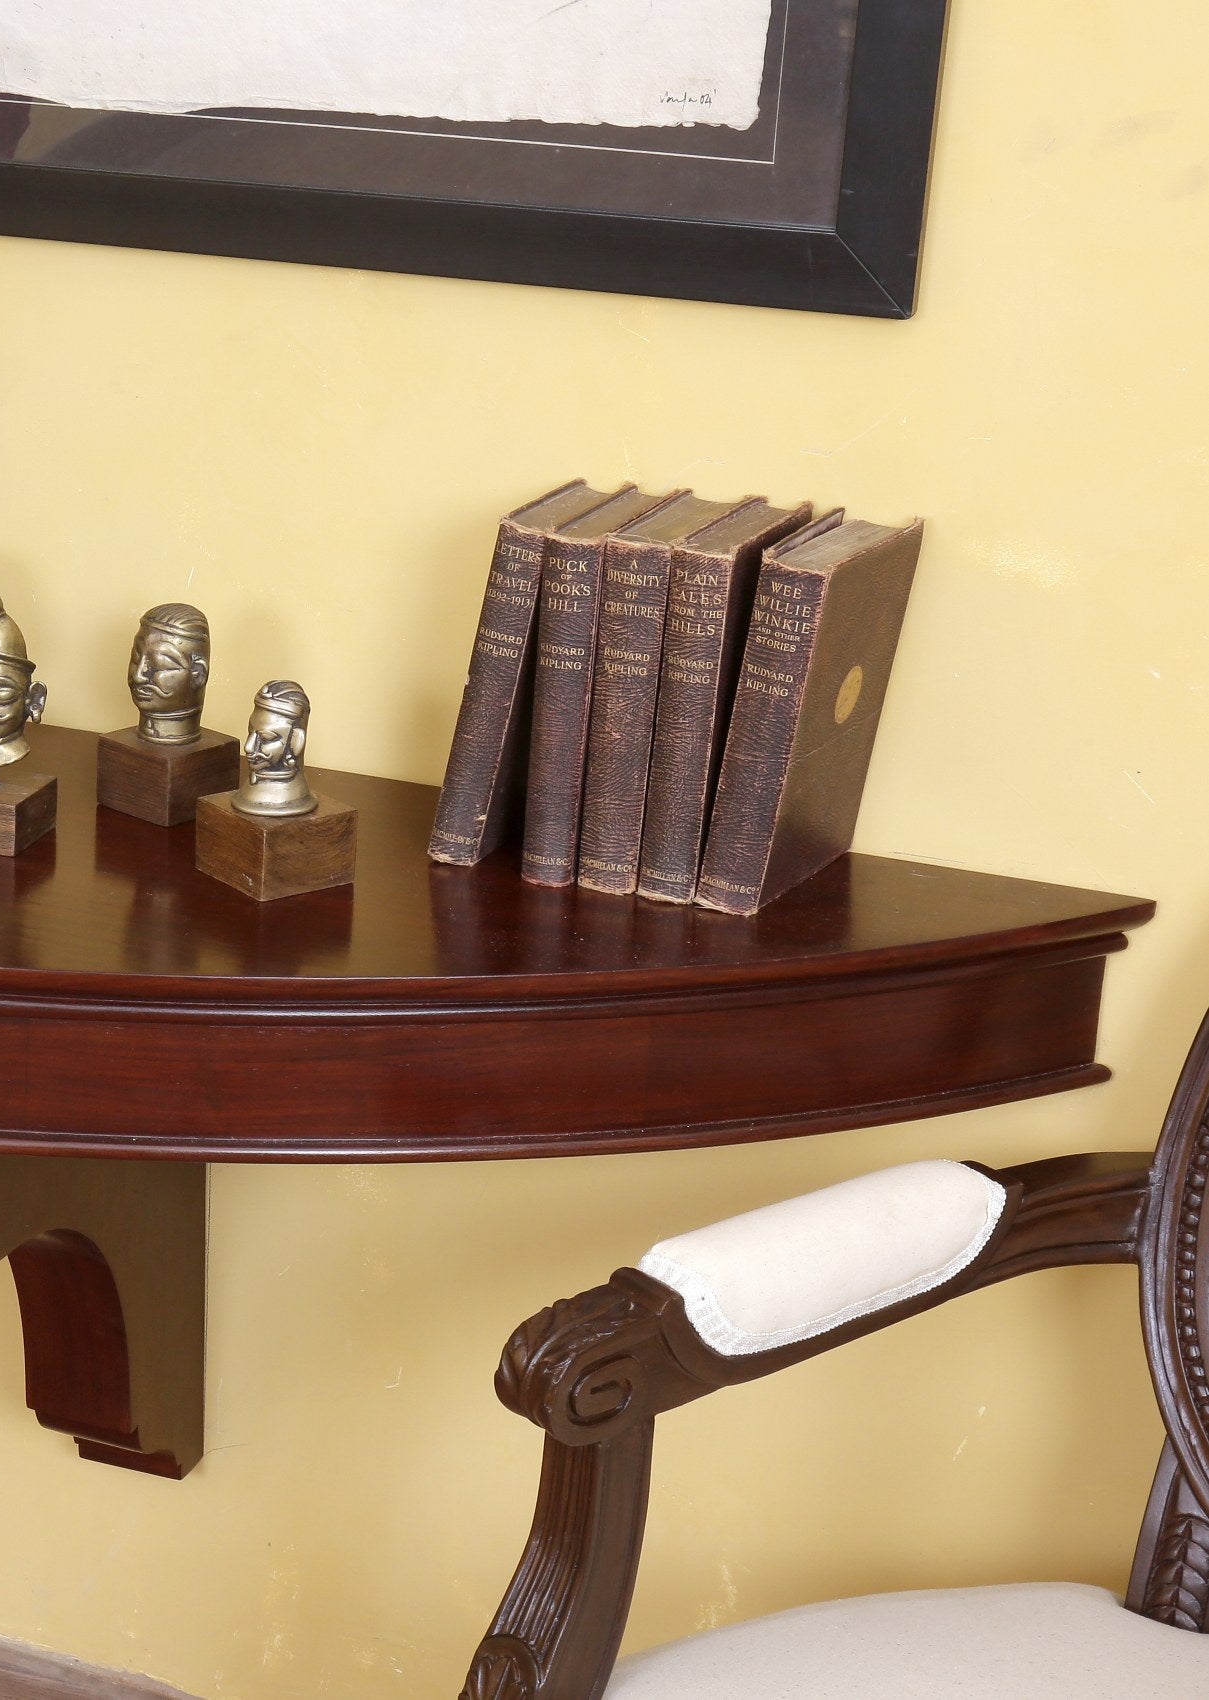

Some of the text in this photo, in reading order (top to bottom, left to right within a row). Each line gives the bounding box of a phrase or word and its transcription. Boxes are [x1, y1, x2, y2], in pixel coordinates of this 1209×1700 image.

[496, 542, 542, 564] LETTERS
[506, 563, 521, 572] OF
[549, 557, 588, 572] PUCK
[631, 559, 638, 569] A
[491, 571, 534, 593] TRAVEL
[560, 573, 572, 581] OF
[607, 569, 663, 587] DIVERSITY
[676, 568, 719, 586] PLAIN
[544, 580, 591, 596] POOK'S
[625, 590, 638, 600] OF
[771, 581, 802, 600] WEE
[548, 597, 582, 613] HILL
[605, 601, 660, 618] CREATURES
[759, 594, 812, 618] WILLIE
[701, 610, 723, 619] THE
[753, 609, 811, 635] WINKIE
[480, 626, 523, 645] RUDYARD
[672, 620, 716, 636] HILLS
[756, 626, 801, 642] AND OTHER
[478, 642, 518, 658] KIPLING
[540, 642, 585, 656] RUDYARD
[755, 635, 797, 653] STORIES
[604, 647, 650, 662] RUDYARD
[540, 657, 582, 670] KIPLING
[604, 662, 647, 676] KIPLING
[667, 656, 714, 670] RUDYARD
[668, 670, 710, 684] KIPLING
[747, 663, 793, 683] RUDYARD
[746, 679, 789, 697] KIPLING
